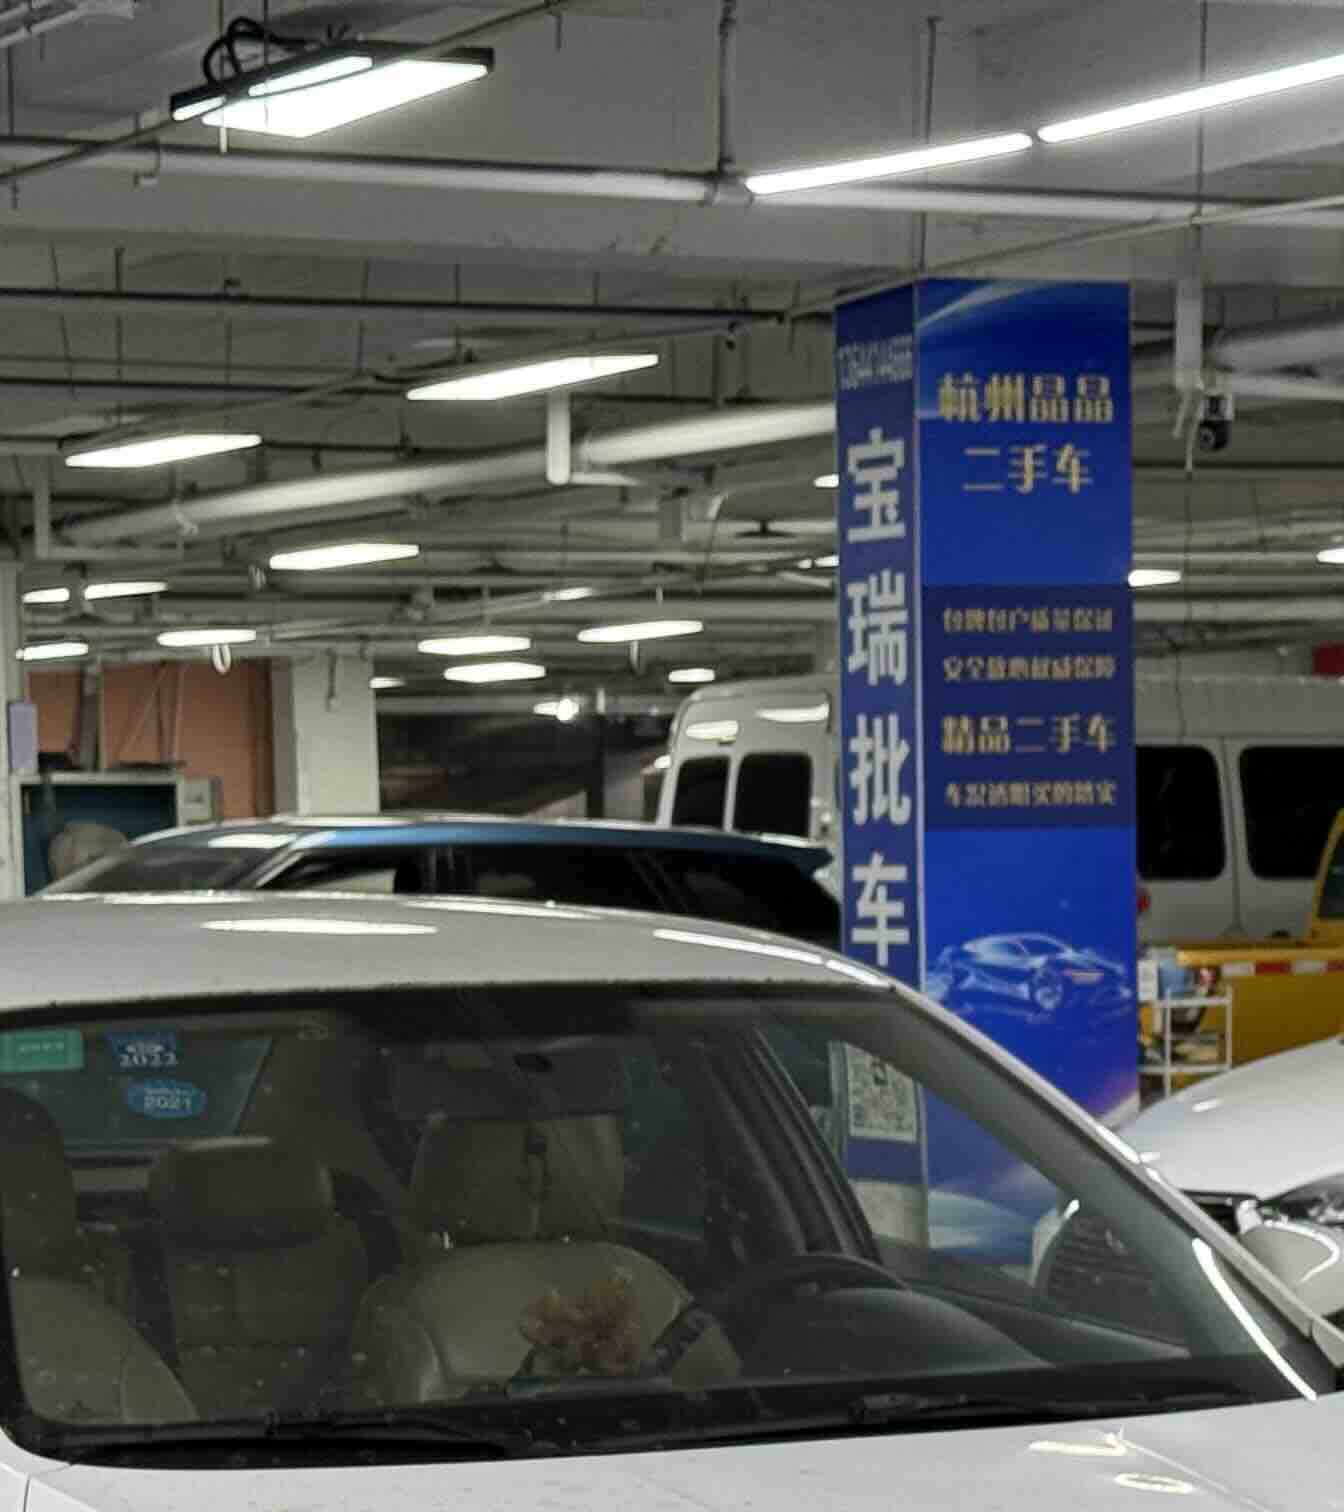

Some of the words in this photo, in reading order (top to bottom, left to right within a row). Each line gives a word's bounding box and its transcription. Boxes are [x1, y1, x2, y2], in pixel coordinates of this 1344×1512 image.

[939, 372, 1114, 423] 杭州品品
[962, 443, 1094, 493] 二手车
[847, 428, 912, 966] 宝瑞批车
